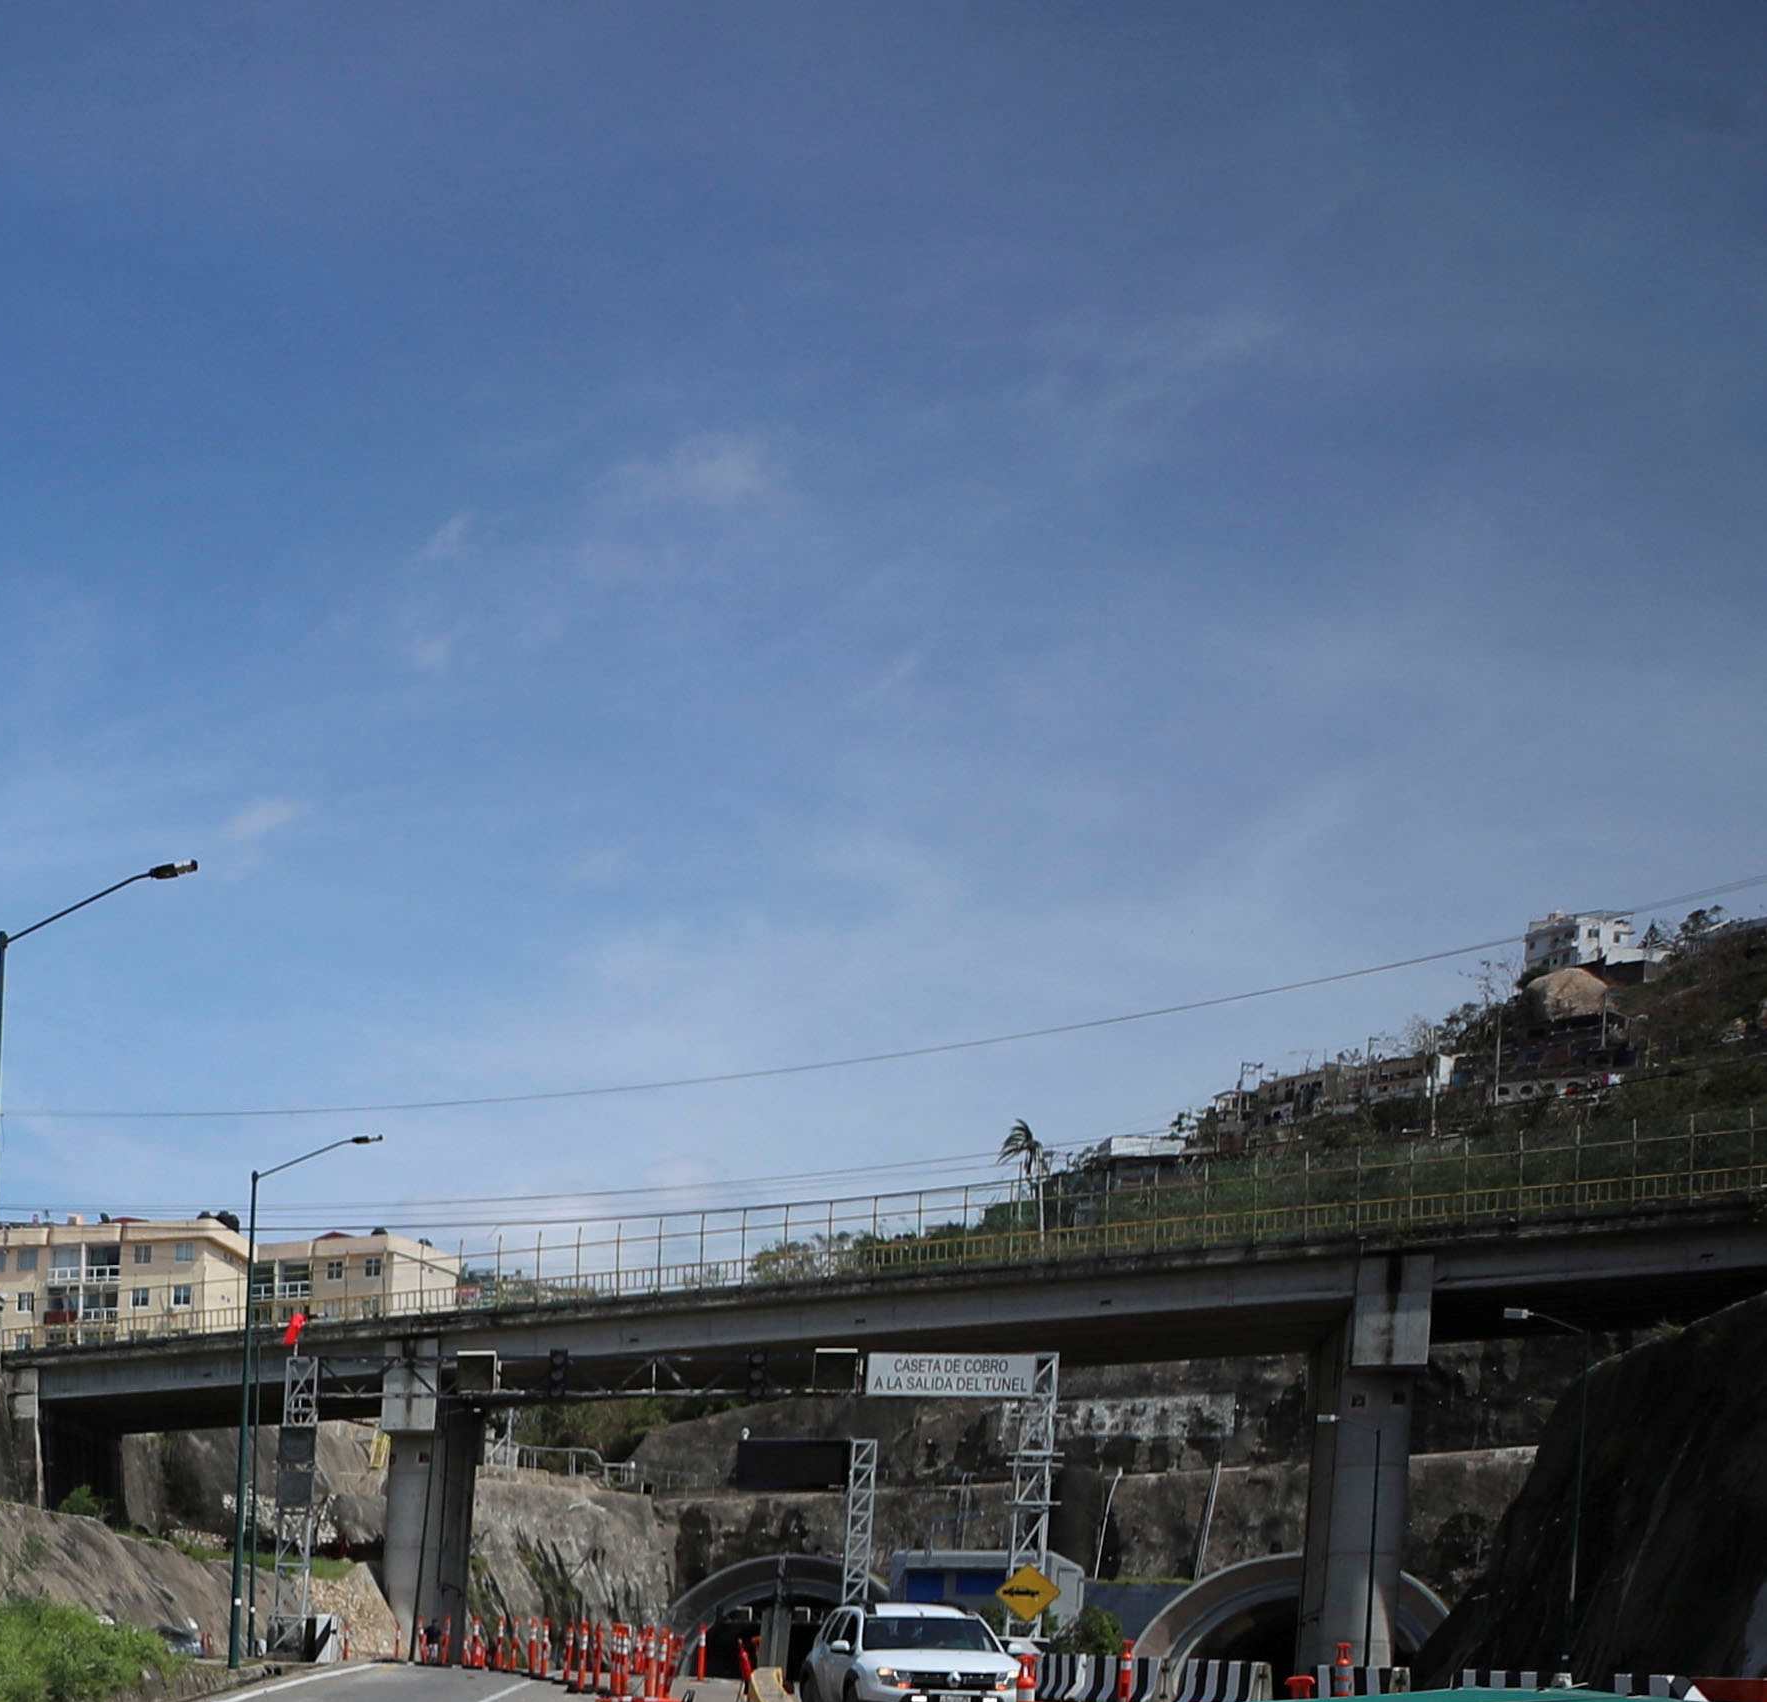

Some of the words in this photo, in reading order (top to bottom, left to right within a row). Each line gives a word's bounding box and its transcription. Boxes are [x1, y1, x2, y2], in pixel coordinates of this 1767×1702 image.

[894, 1358, 941, 1374] CASETA
[944, 1358, 961, 1374] DE
[964, 1358, 1009, 1374] COBRO
[874, 1376, 883, 1391] A
[886, 1376, 903, 1391] LA
[906, 1376, 953, 1391] SALIDA
[956, 1377, 981, 1392] DEL
[984, 1377, 1028, 1393] TUNEL
